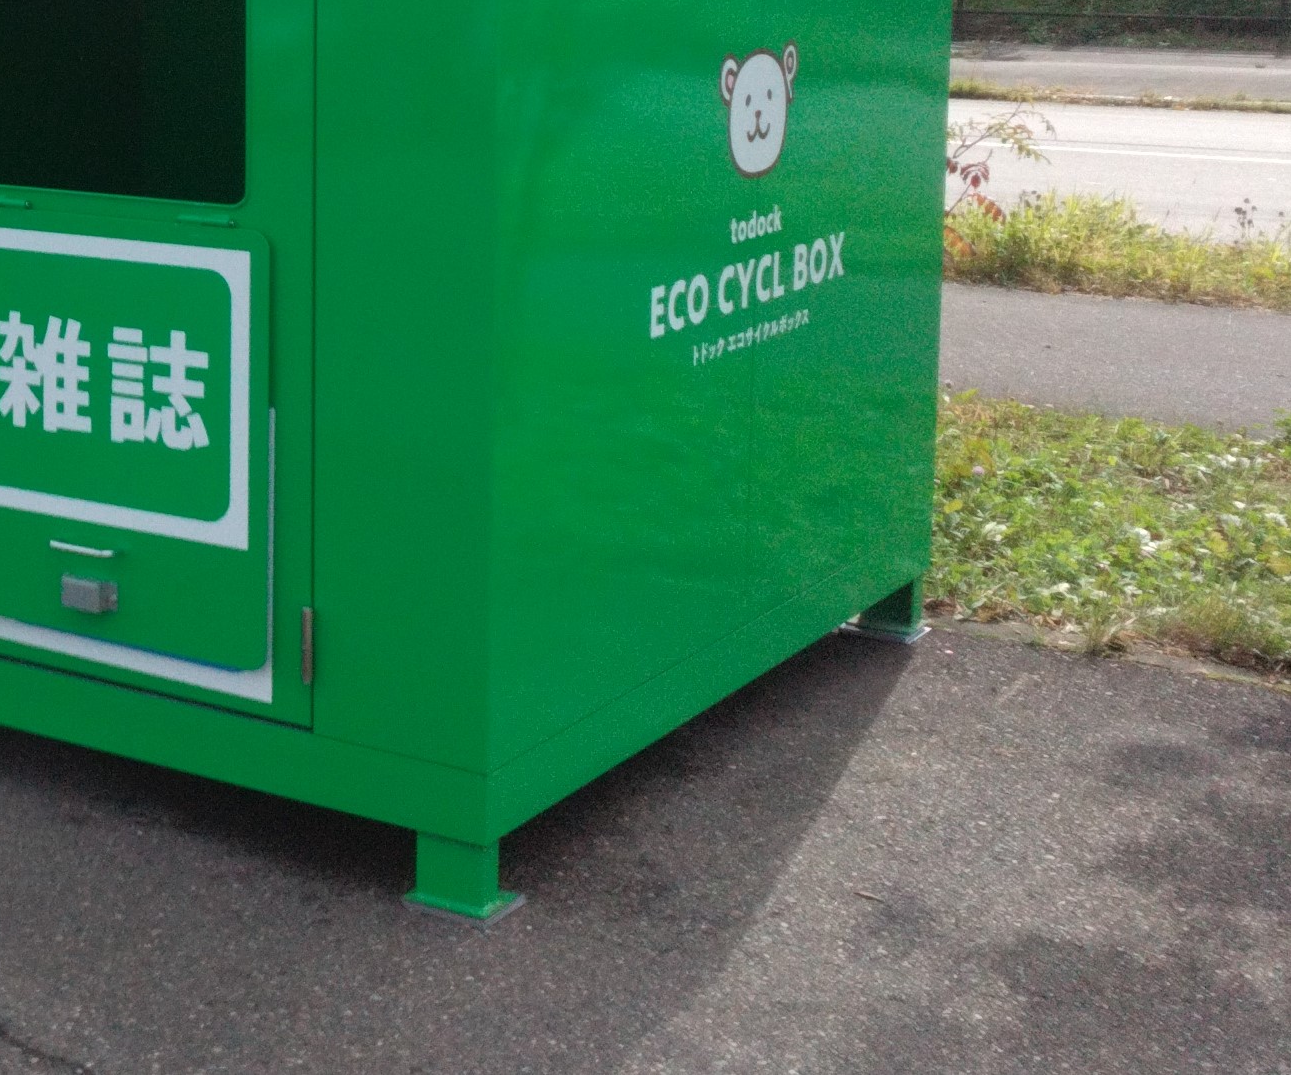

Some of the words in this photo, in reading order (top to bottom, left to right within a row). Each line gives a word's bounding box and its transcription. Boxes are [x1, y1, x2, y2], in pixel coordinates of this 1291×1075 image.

[730, 204, 782, 245] todock
[650, 273, 709, 339] ECO
[717, 251, 785, 315] CYCL
[793, 231, 844, 291] BOX
